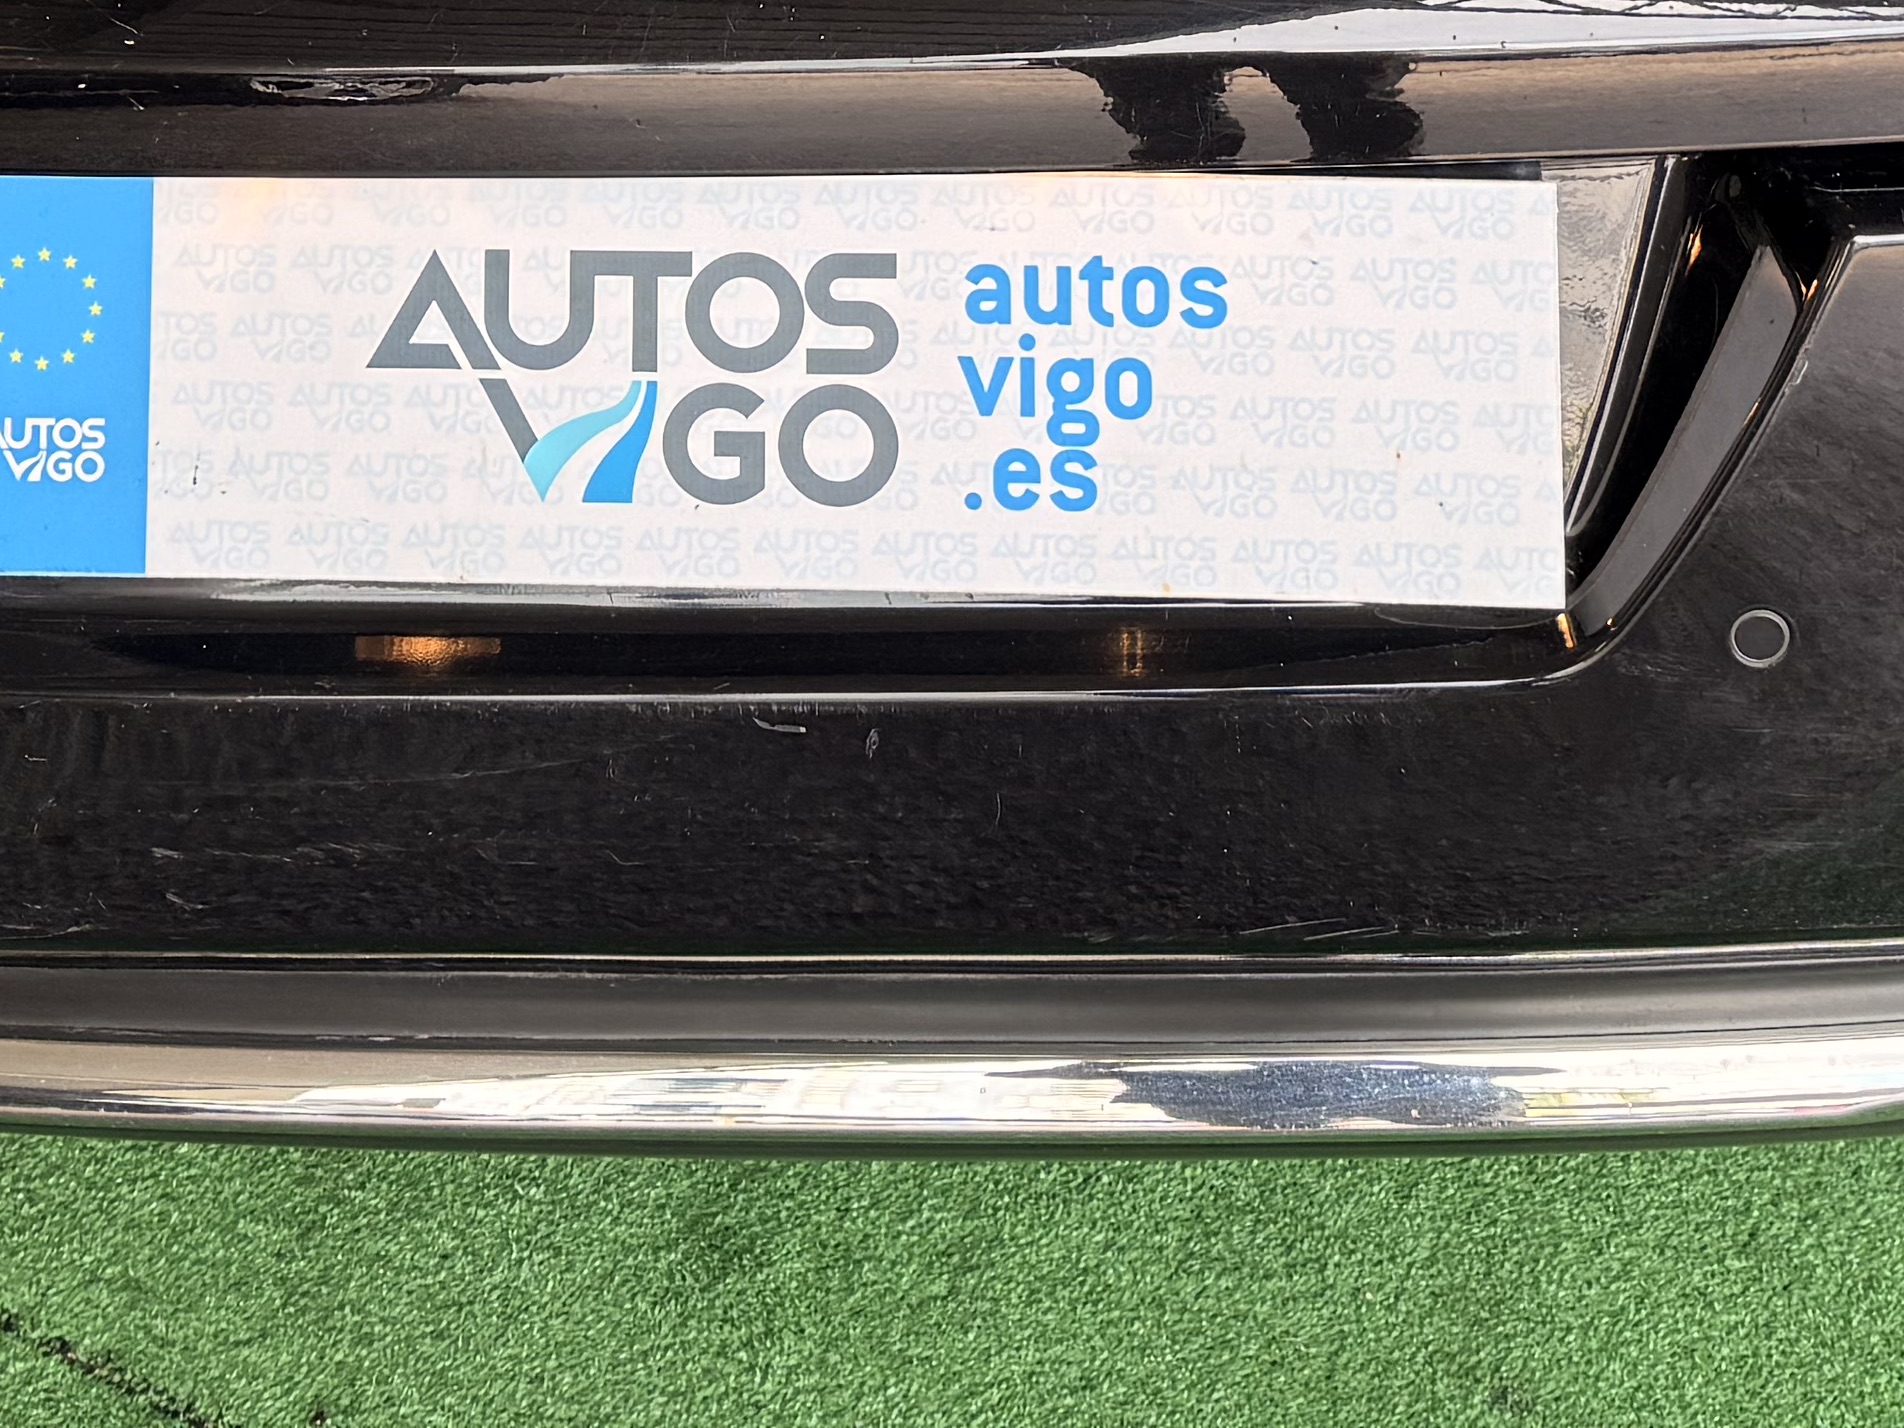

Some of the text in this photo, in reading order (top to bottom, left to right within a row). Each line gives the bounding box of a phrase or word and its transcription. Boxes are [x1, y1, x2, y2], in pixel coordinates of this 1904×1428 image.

[365, 249, 900, 375] AUTOS
[963, 255, 1229, 329] autos
[957, 332, 1153, 448] vigo
[2, 450, 107, 483] VIGO
[478, 377, 900, 508] VIGO
[964, 446, 1099, 513] .es
